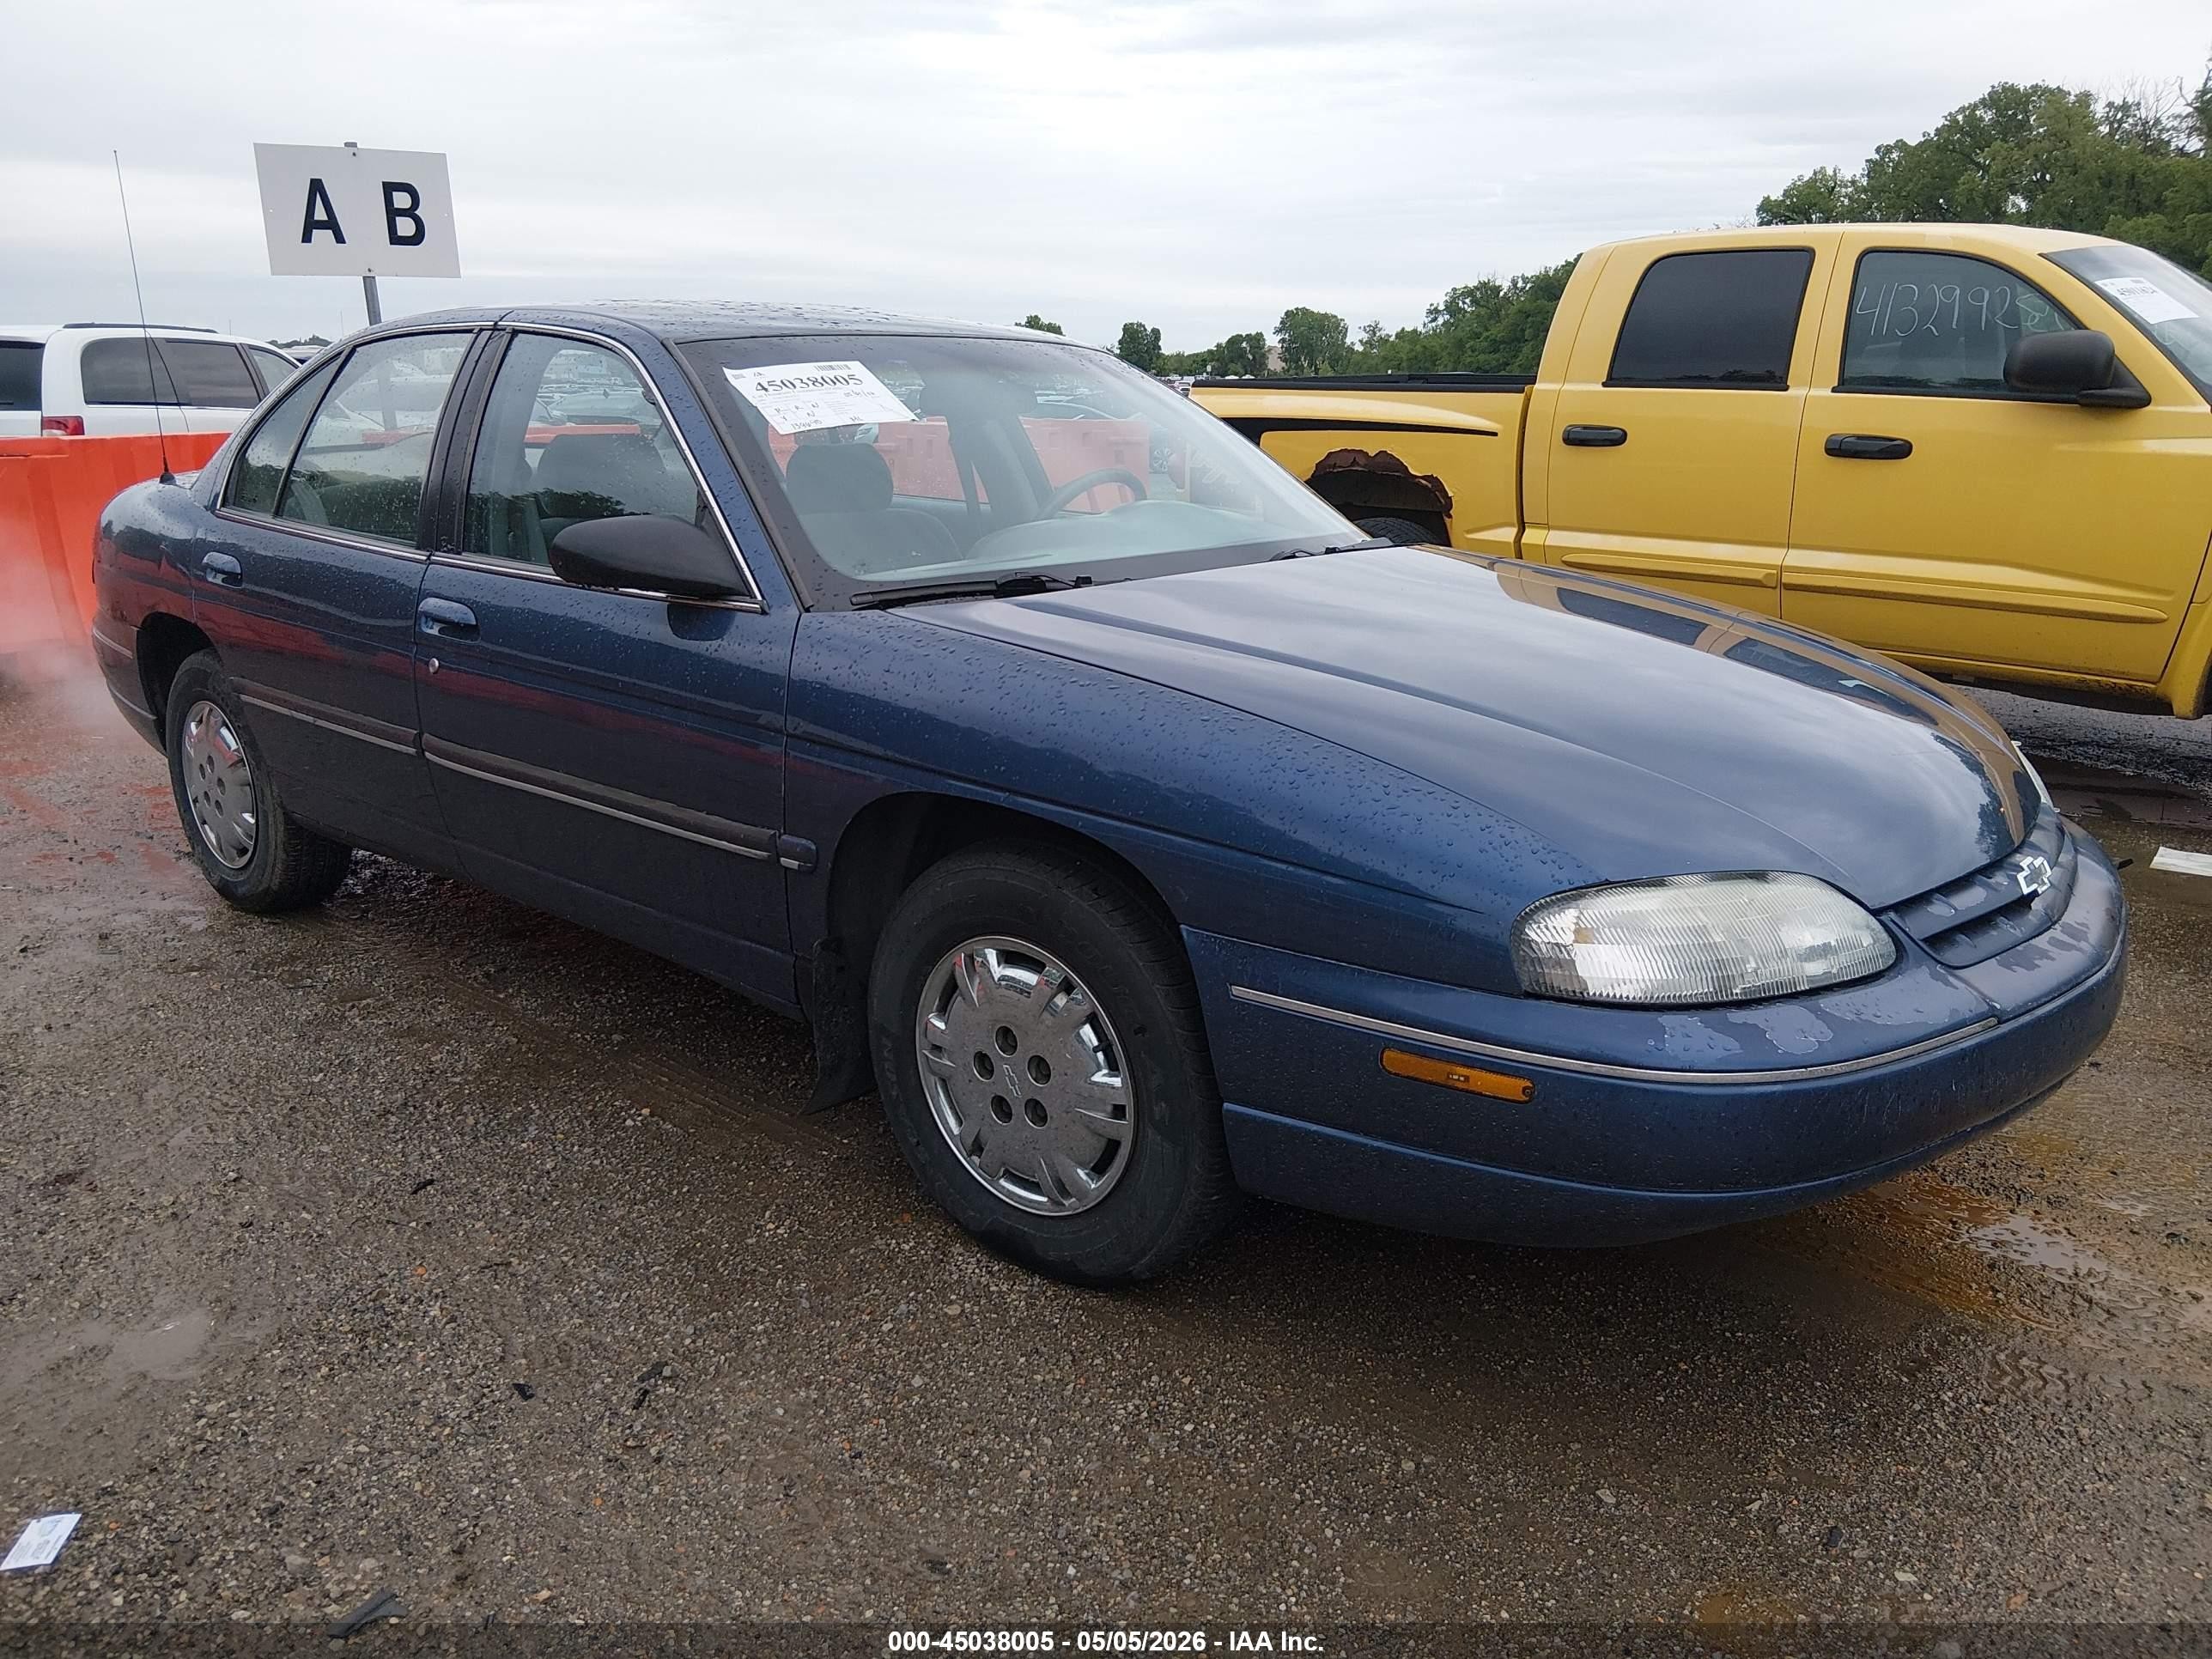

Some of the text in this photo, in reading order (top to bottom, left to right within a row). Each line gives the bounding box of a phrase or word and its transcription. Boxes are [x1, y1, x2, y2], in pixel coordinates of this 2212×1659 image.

[301, 178, 426, 246] A B
[755, 374, 863, 392] 45038005
